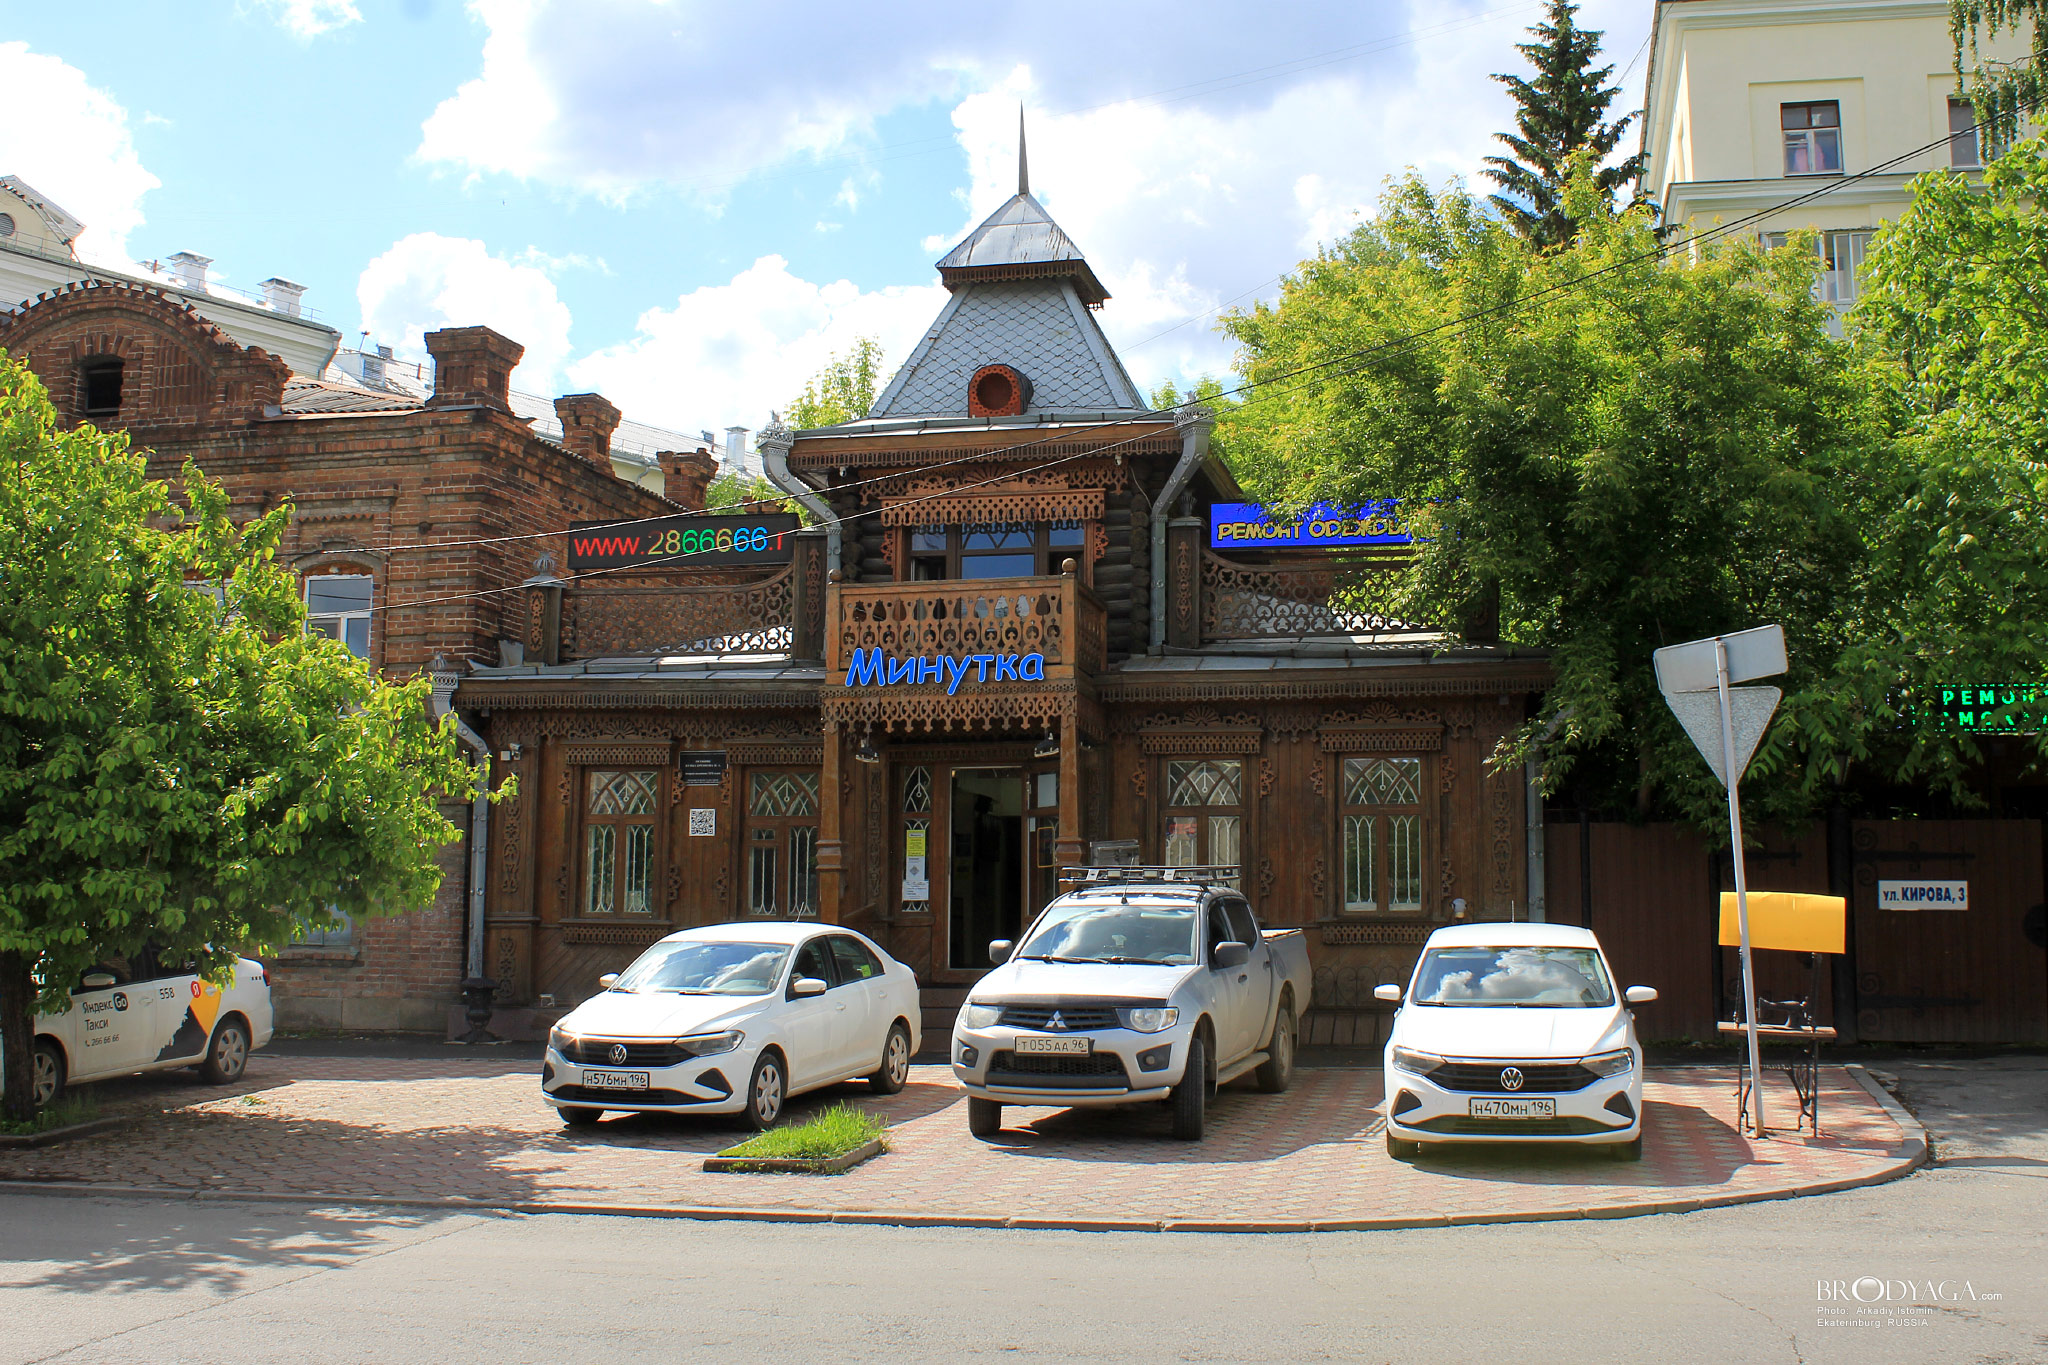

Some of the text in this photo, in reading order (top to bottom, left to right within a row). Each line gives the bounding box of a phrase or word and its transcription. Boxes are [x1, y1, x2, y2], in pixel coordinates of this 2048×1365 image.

[1217, 521, 1304, 540] РЕМОНТ
[844, 646, 1045, 696] Минутка
[1883, 886, 1966, 905] ул. КИРОВА, 3
[160, 987, 175, 999] 558
[82, 995, 127, 1013] Яндекс Go
[84, 1018, 109, 1031] Такси
